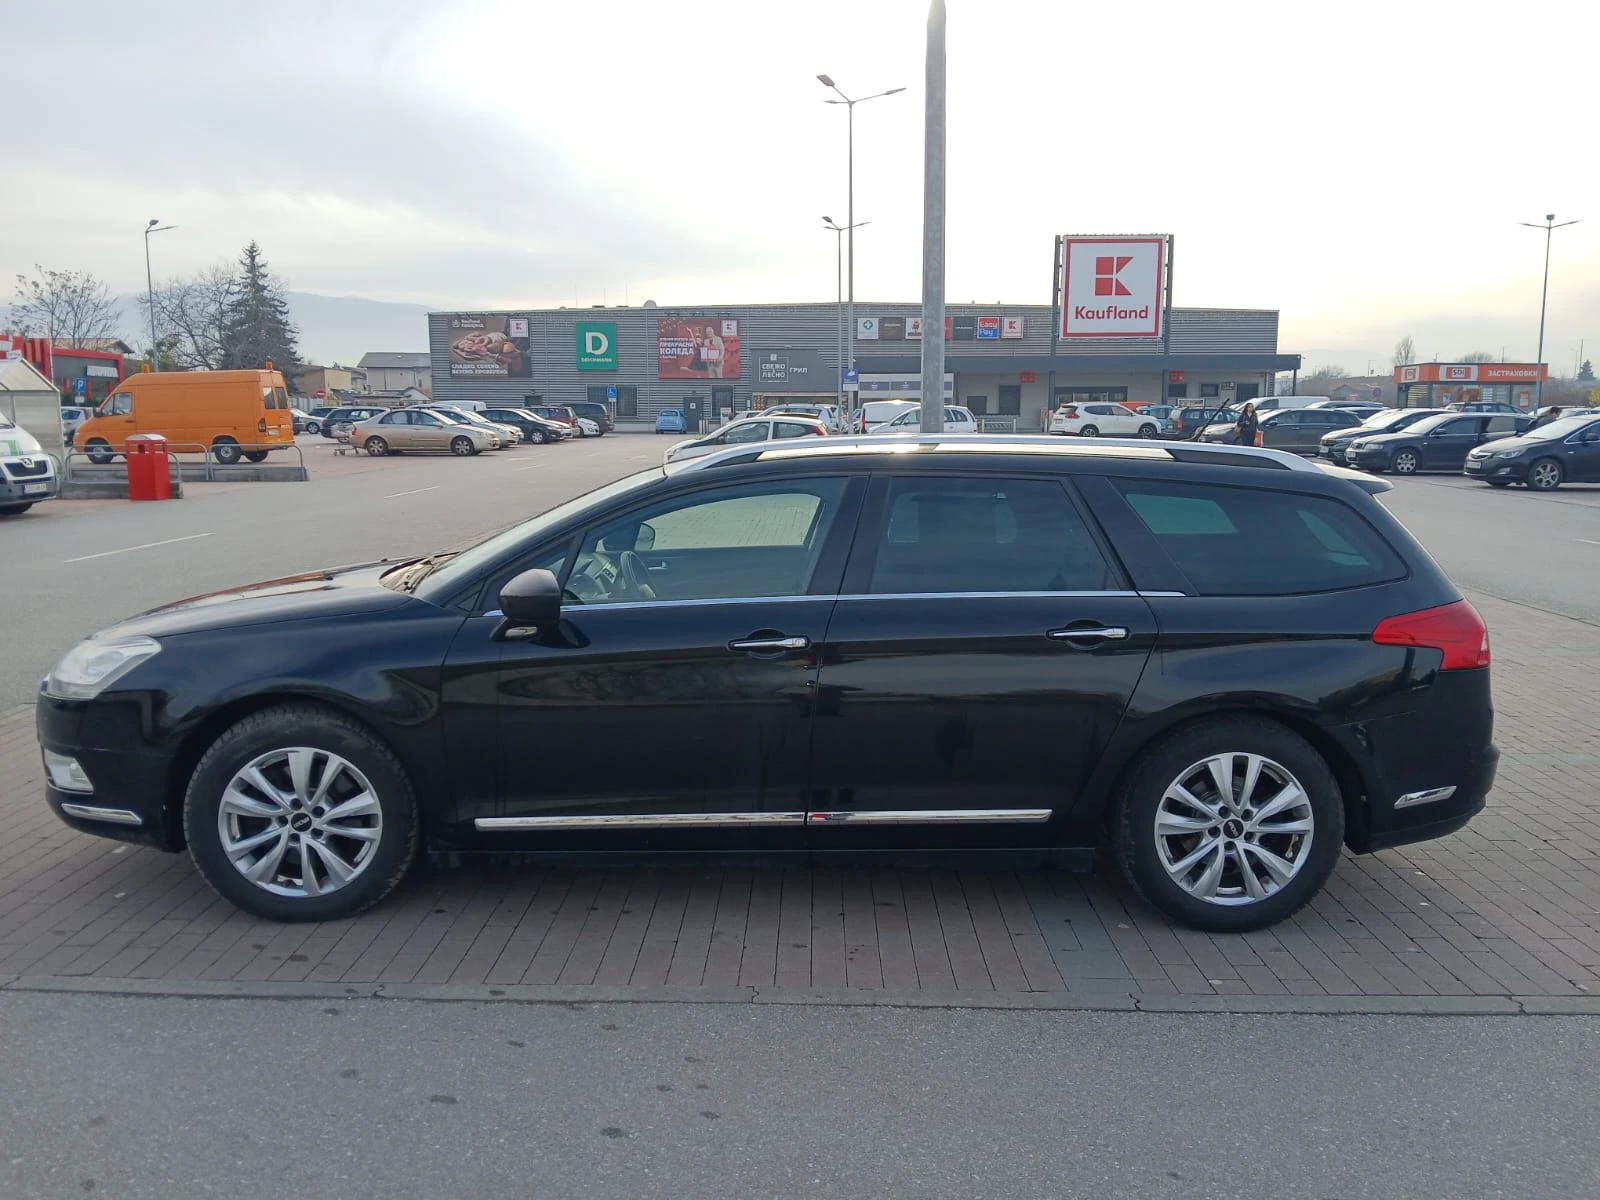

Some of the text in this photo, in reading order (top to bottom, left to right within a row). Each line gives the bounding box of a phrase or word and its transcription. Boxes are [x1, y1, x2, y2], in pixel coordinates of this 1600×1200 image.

[1075, 305, 1149, 320] Kaufland
[585, 331, 609, 355] D
[659, 347, 695, 356] КОЛЕДА
[1488, 369, 1538, 377] ЗАСТРАХОВКИ
